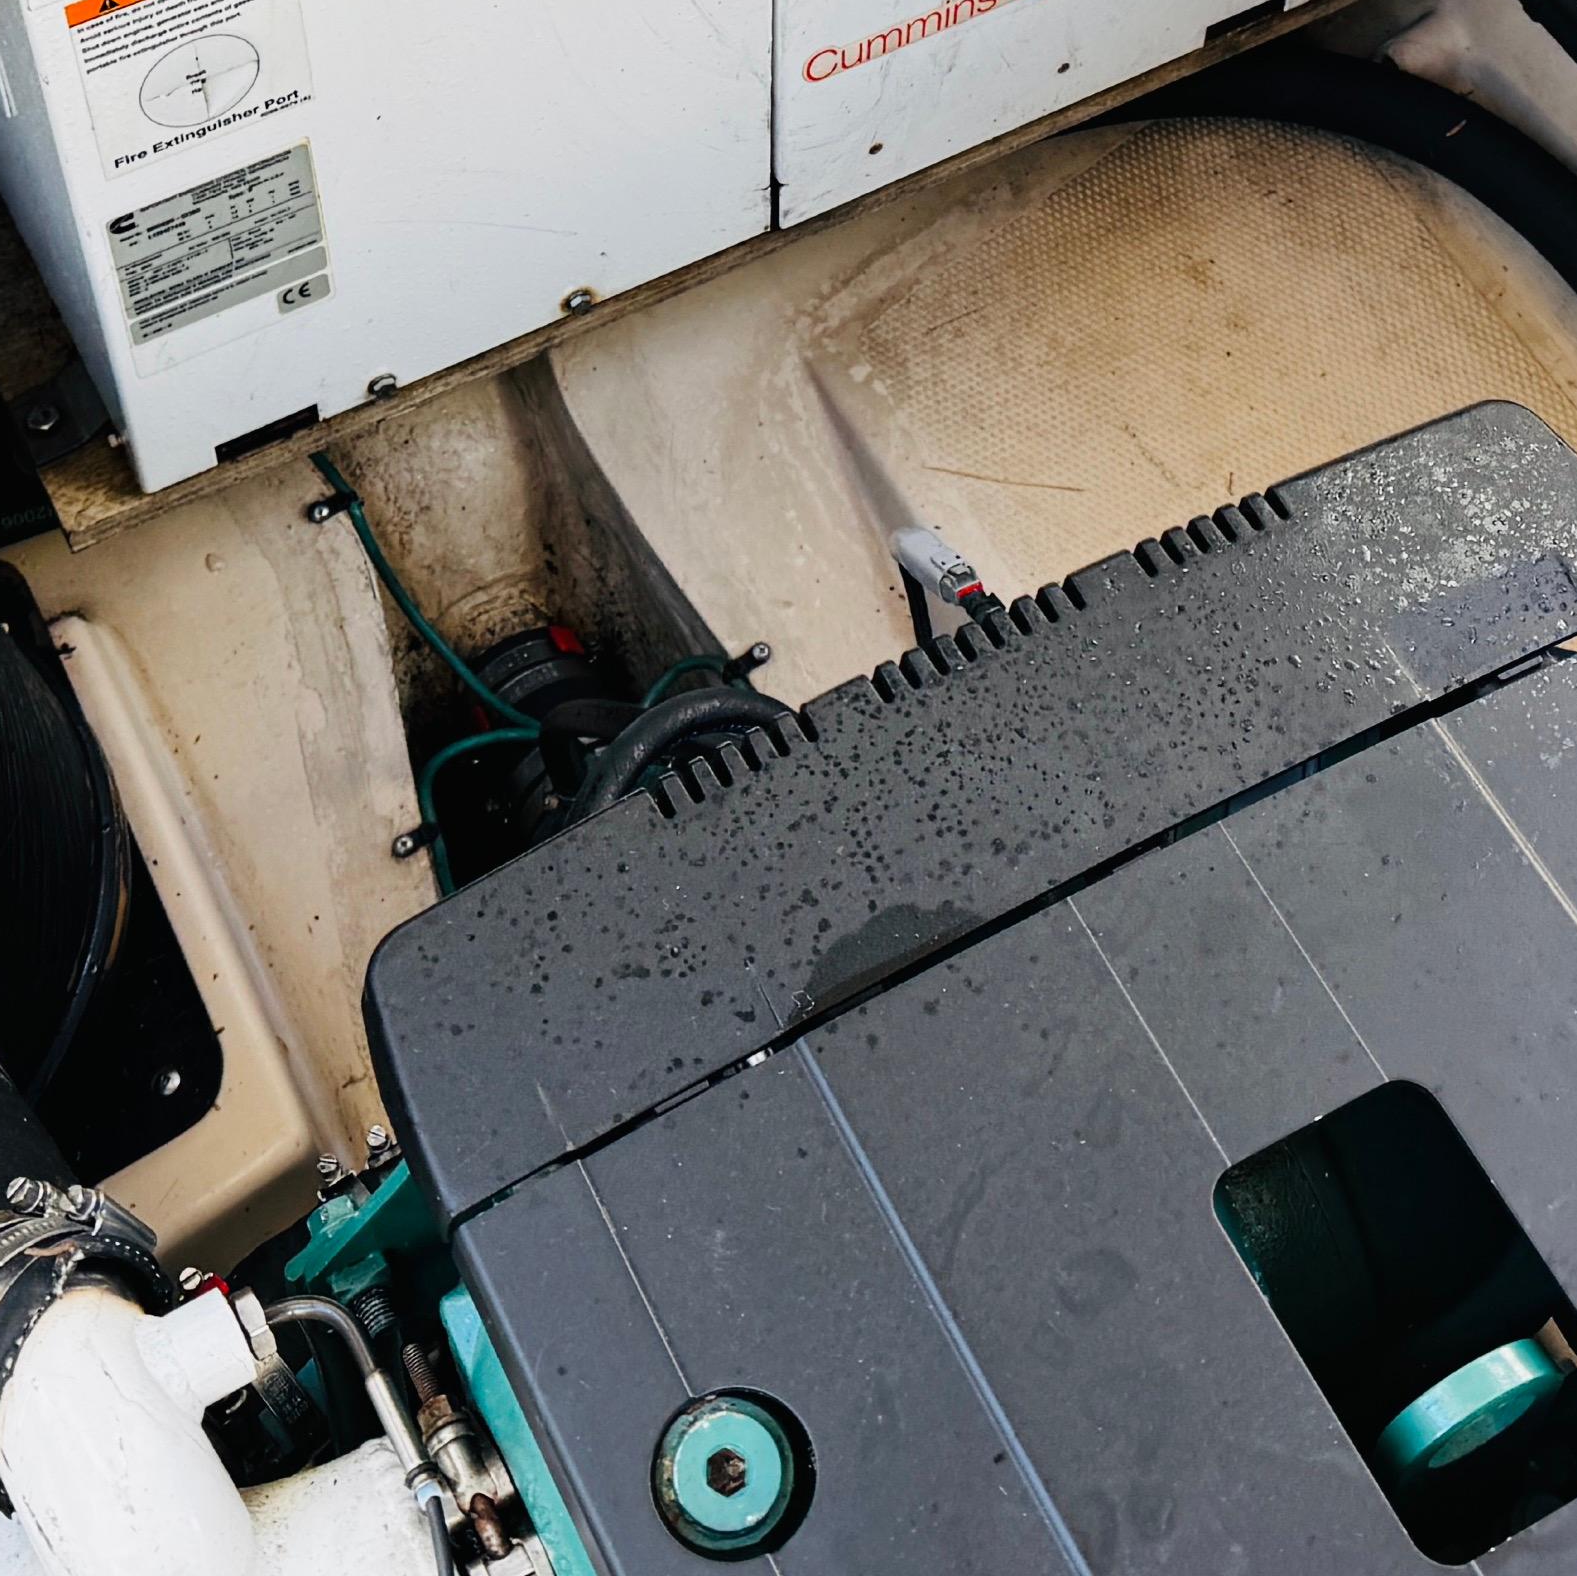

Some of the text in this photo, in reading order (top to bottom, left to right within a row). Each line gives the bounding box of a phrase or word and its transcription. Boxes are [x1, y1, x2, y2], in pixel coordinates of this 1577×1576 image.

[114, 150, 147, 169] Fire
[152, 106, 260, 154] Extinguisher
[264, 89, 299, 110] Port
